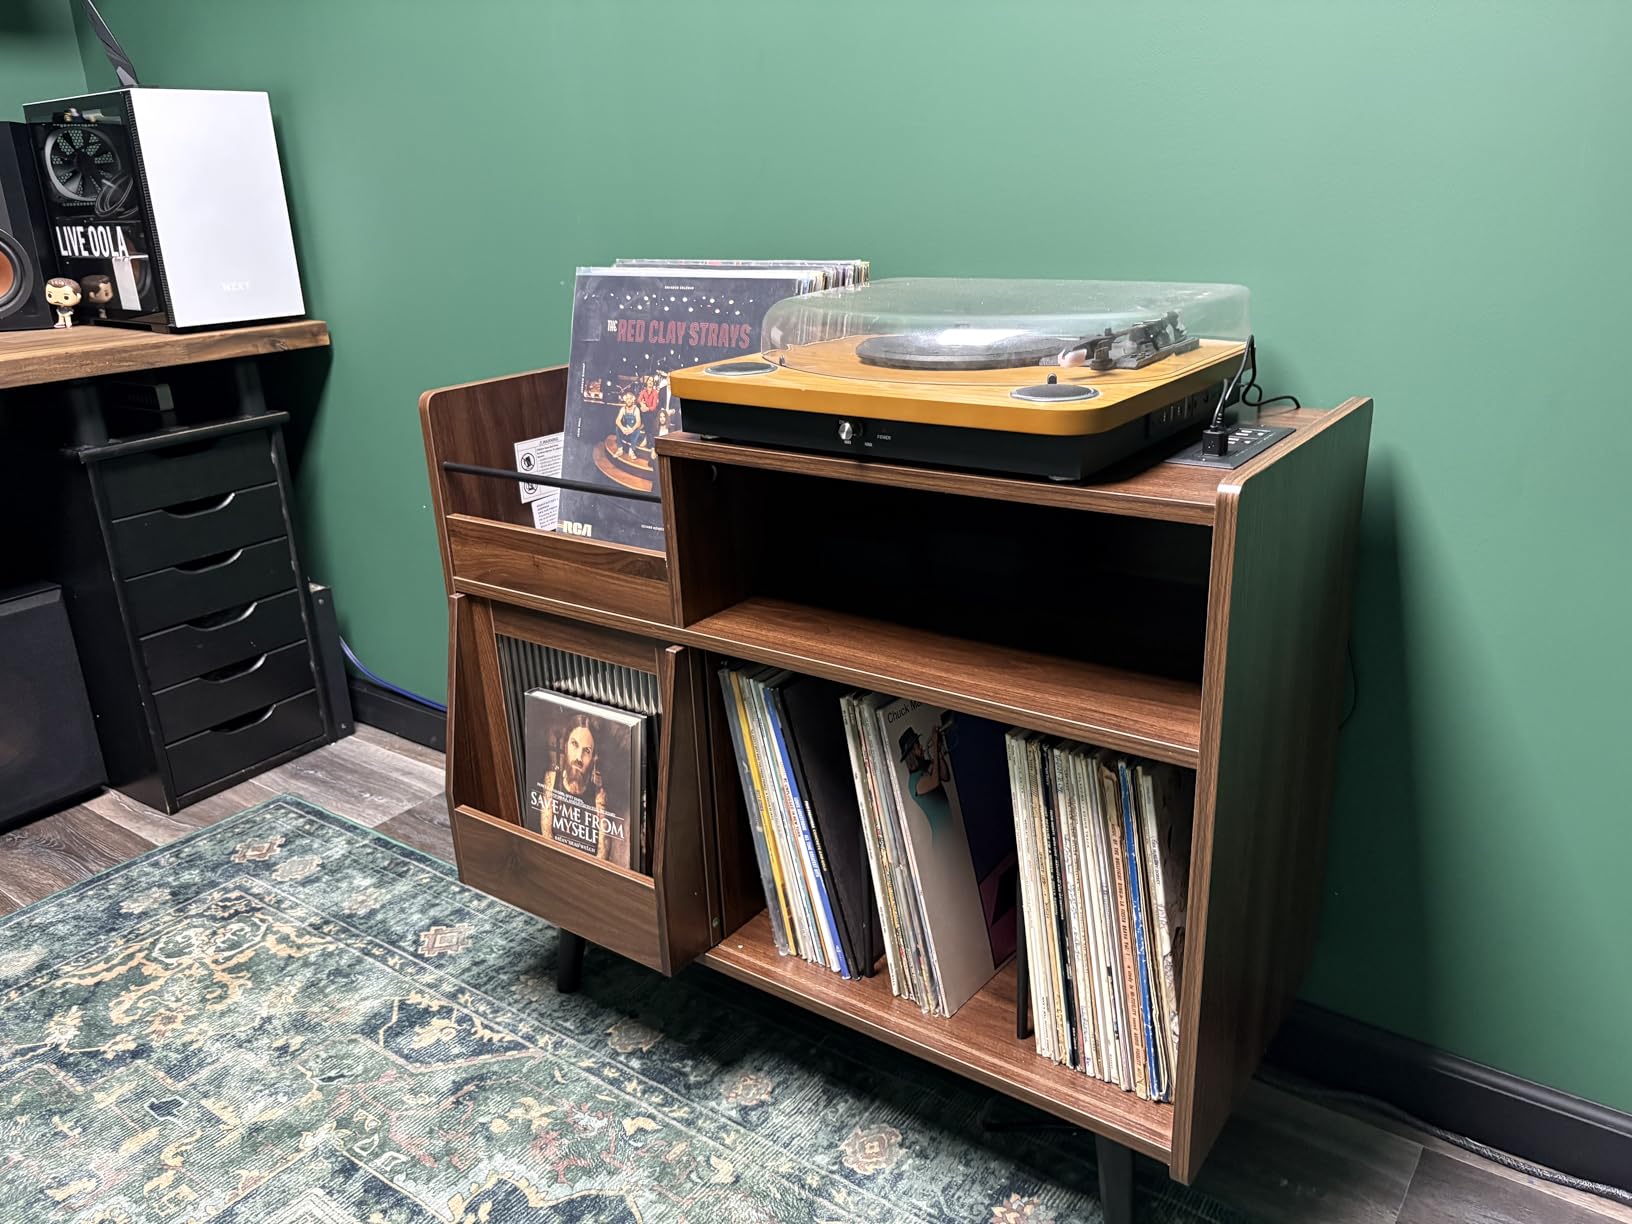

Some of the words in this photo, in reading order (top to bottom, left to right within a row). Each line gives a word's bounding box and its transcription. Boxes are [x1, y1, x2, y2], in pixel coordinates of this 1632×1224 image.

[55, 226, 89, 257] LIVE
[607, 319, 618, 332] THE
[618, 319, 646, 343] RED
[648, 320, 687, 345] CLAY
[689, 321, 752, 349] STRAYS
[563, 520, 593, 538] RCA
[887, 703, 910, 723] Chuck
[530, 791, 560, 814] SAVE
[585, 811, 624, 839] FROM
[553, 815, 600, 844] MYSELF
